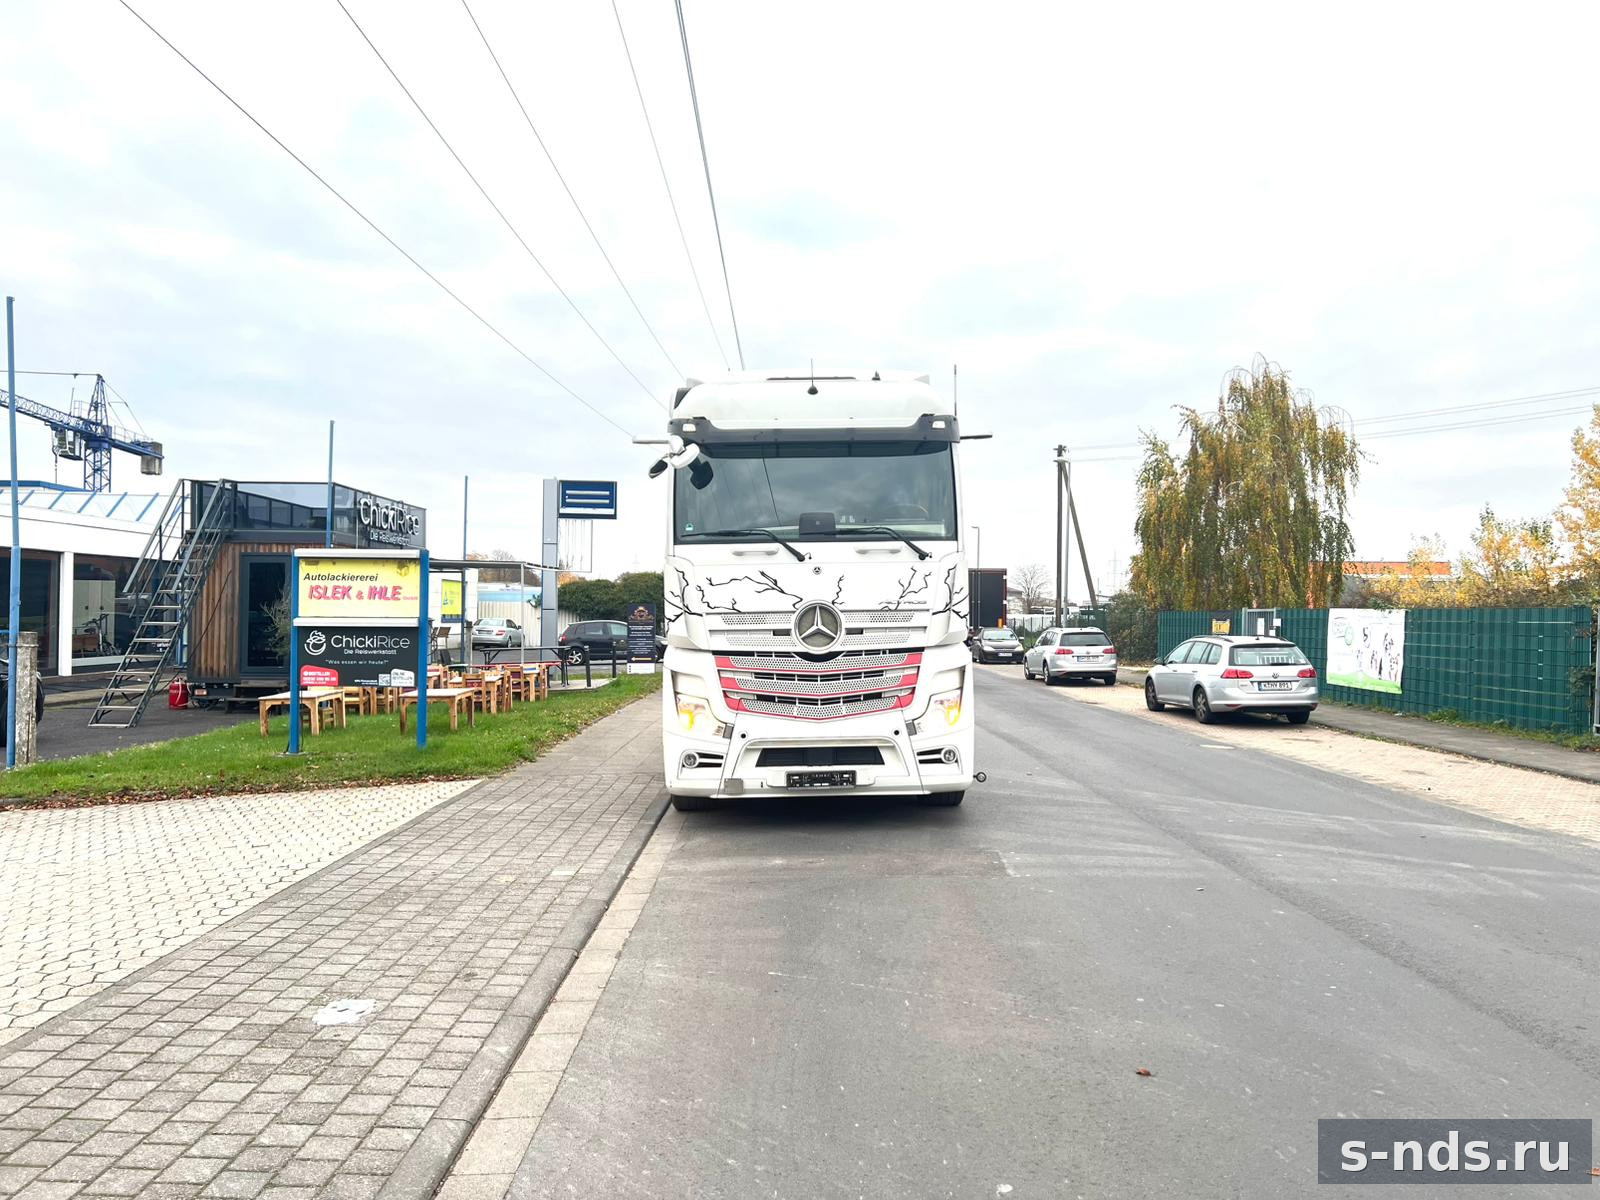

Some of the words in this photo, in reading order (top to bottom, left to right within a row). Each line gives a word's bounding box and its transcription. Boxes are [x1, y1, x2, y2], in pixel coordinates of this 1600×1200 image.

[360, 497, 419, 535] ChickiRice
[303, 573, 379, 582] Autolackiererei
[308, 585, 353, 600] ISLEK
[367, 586, 402, 601] IHLE
[331, 635, 410, 649] ChickiRice
